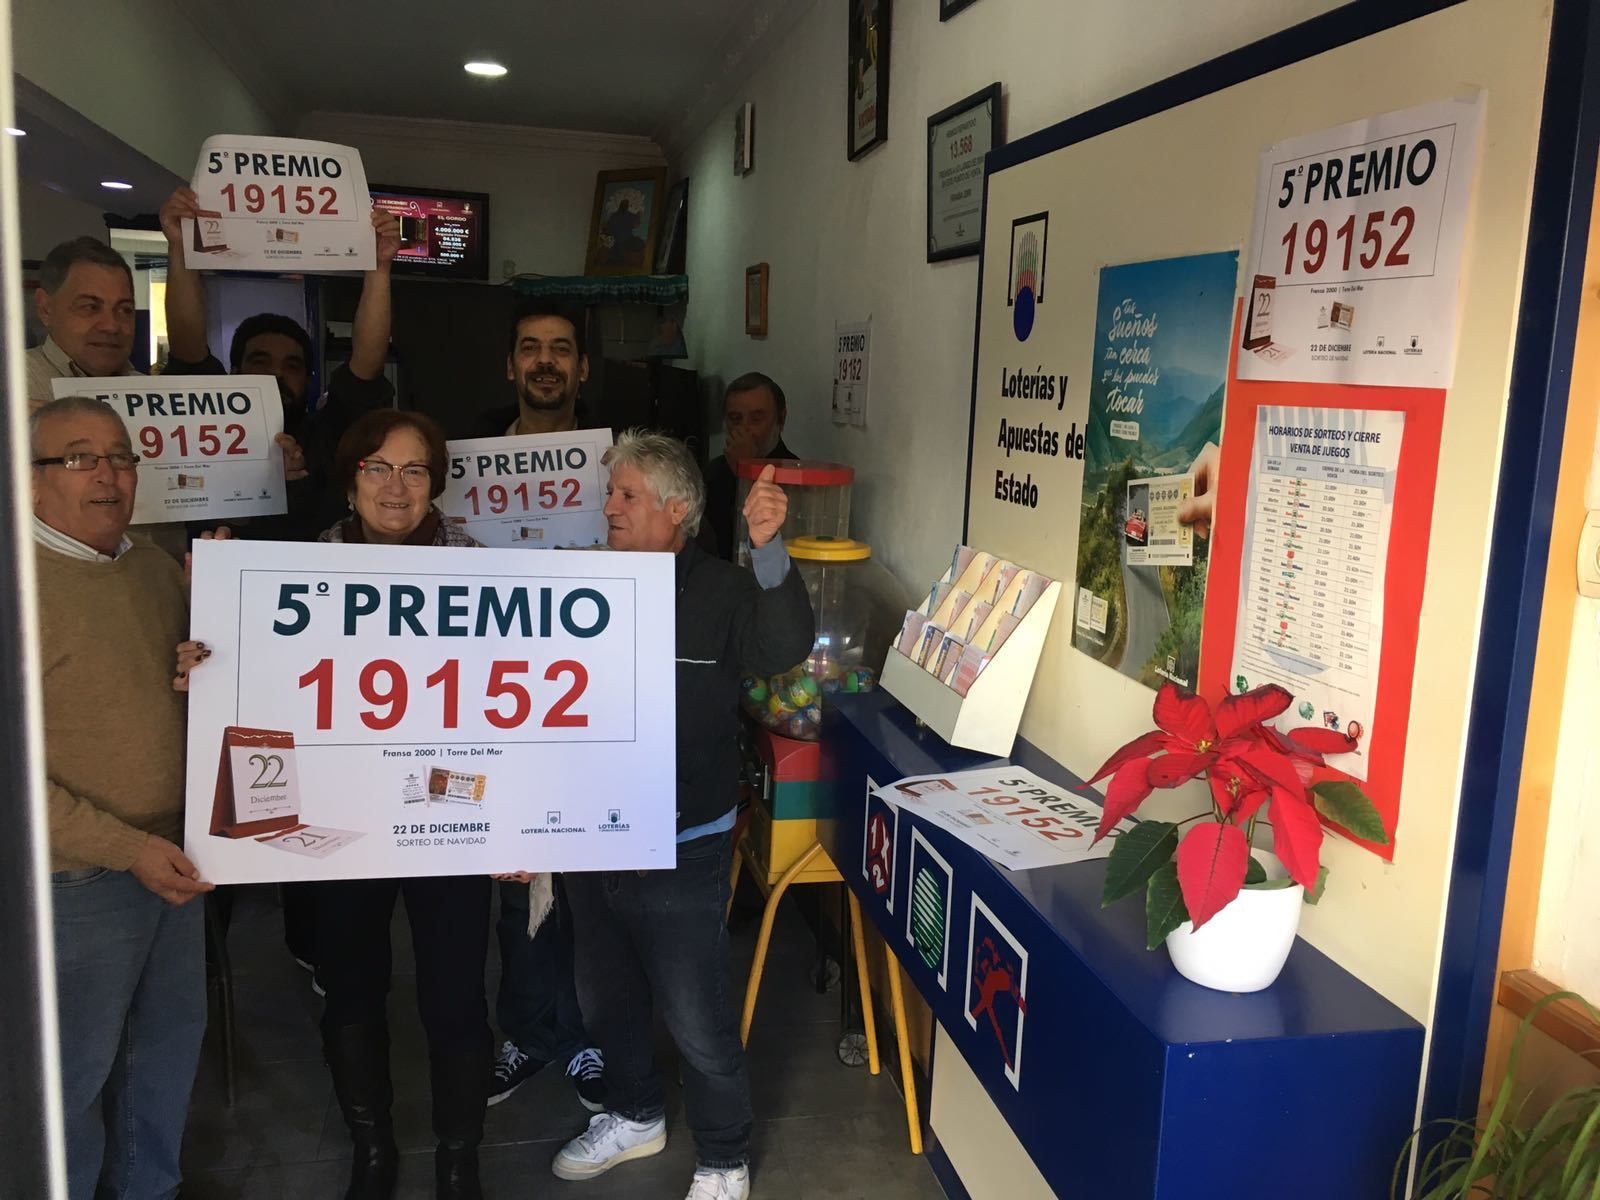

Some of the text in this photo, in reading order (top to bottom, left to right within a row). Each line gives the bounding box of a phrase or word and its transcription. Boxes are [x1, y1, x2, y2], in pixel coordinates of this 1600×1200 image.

[234, 152, 342, 179] PREMIO
[1304, 139, 1437, 205] PREMIO
[220, 183, 339, 215] 19152
[1281, 206, 1416, 275] 19152
[1108, 305, 1158, 342] Sueños
[1119, 340, 1151, 365] cerca
[125, 392, 251, 417] PREMIO
[1001, 365, 1068, 411] Loterías y
[139, 423, 249, 459] 9152
[997, 418, 1059, 458] Apuestas
[1268, 425, 1381, 443] HORARIOS DE SORTEOS Y CIERRE
[1290, 443, 1351, 458] VENTA DE JUEGOS
[476, 447, 587, 478] PREMIO
[464, 478, 582, 516] 19152
[994, 469, 1038, 509] Estado
[272, 581, 611, 639] 5º PREMIO
[298, 658, 590, 731] 19152
[382, 748, 503, 757] Fransa 2000 Torre Del Mar
[248, 754, 288, 789] 22
[392, 822, 491, 835] 22 DE DICIEMBRE
[598, 821, 631, 829] LOTERÍAS
[967, 786, 1084, 841] 19152
[396, 837, 487, 847] SORTEO DE NAVIDAD
[521, 827, 549, 835] LOTERÍA
